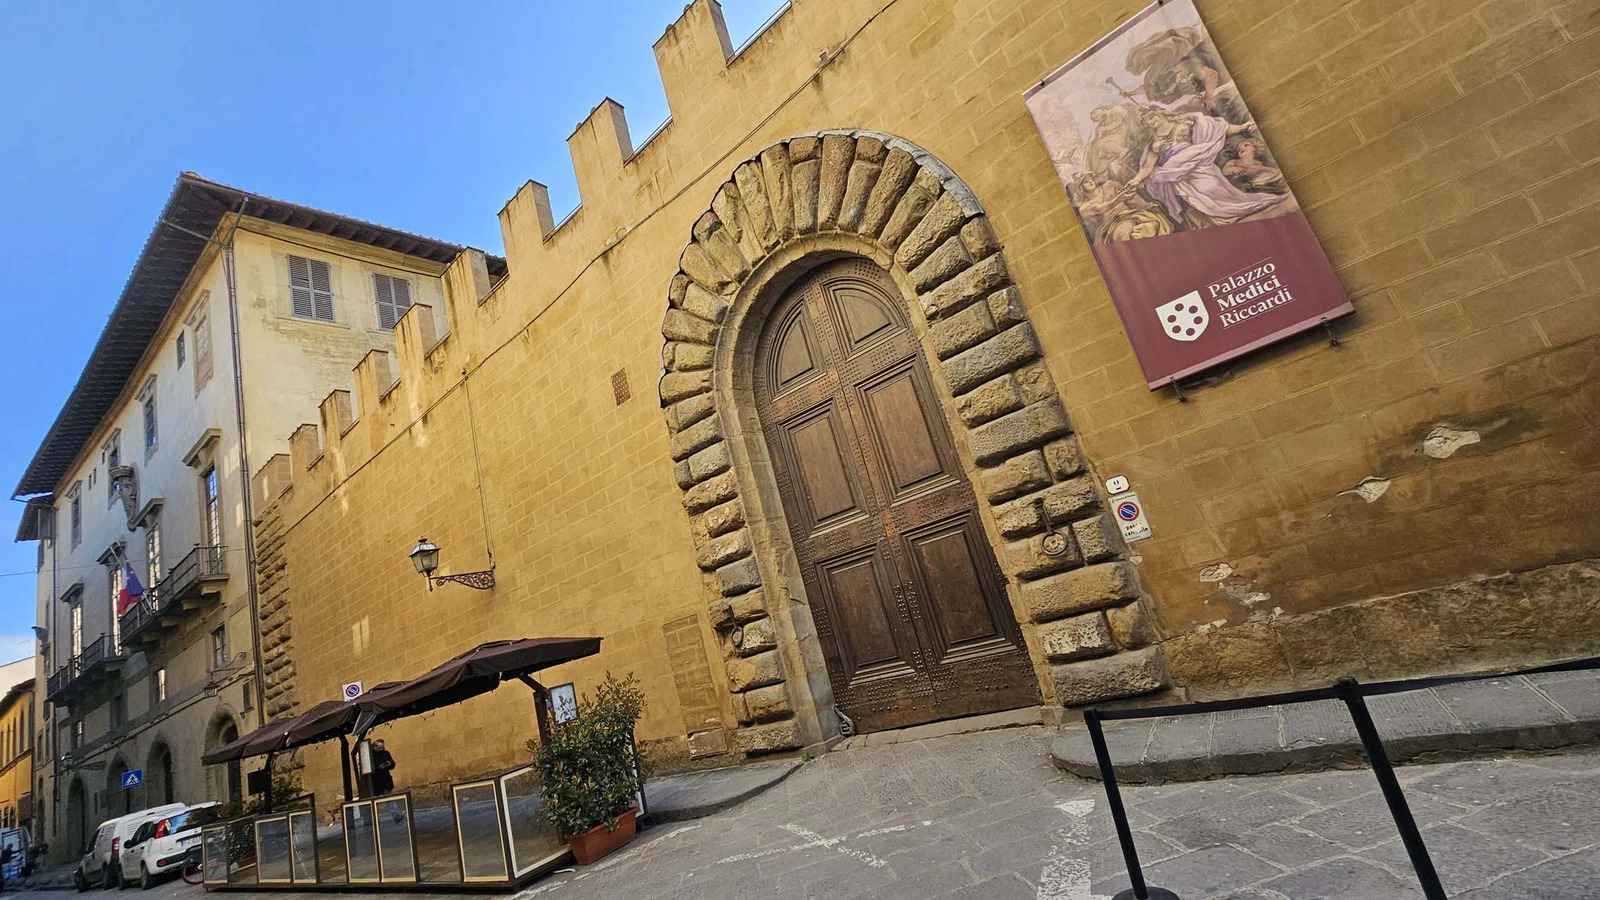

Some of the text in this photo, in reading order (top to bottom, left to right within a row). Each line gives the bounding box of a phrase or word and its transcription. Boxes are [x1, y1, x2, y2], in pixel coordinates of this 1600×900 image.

[1208, 263, 1276, 298] Palazzo
[1217, 275, 1282, 311] Medici
[1219, 288, 1293, 328] Riccardi
